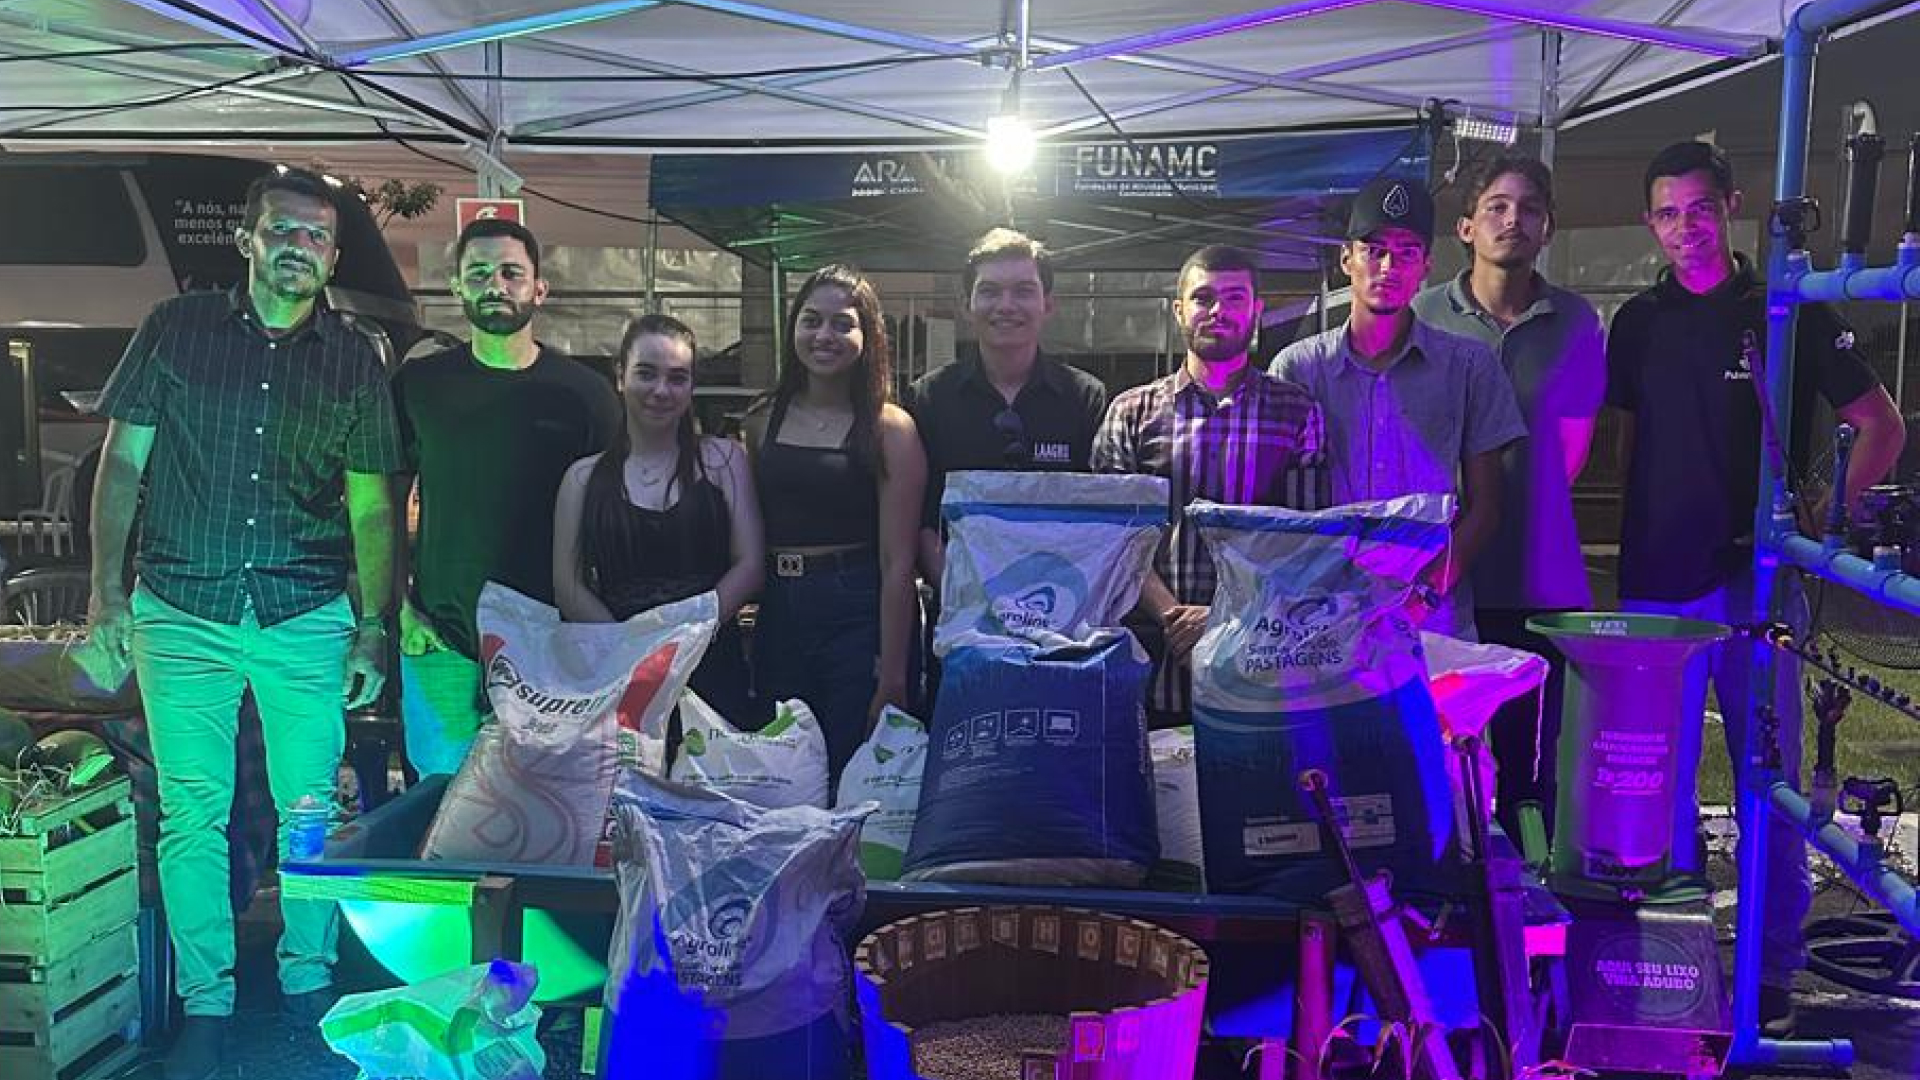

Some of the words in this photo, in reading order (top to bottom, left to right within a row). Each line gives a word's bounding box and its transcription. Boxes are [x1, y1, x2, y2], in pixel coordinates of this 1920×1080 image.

[1076, 146, 1217, 176] FUNAMC
[174, 218, 222, 229] menos
[1245, 648, 1344, 673] PASTAGENS
[1643, 976, 1697, 991] ADUBO
